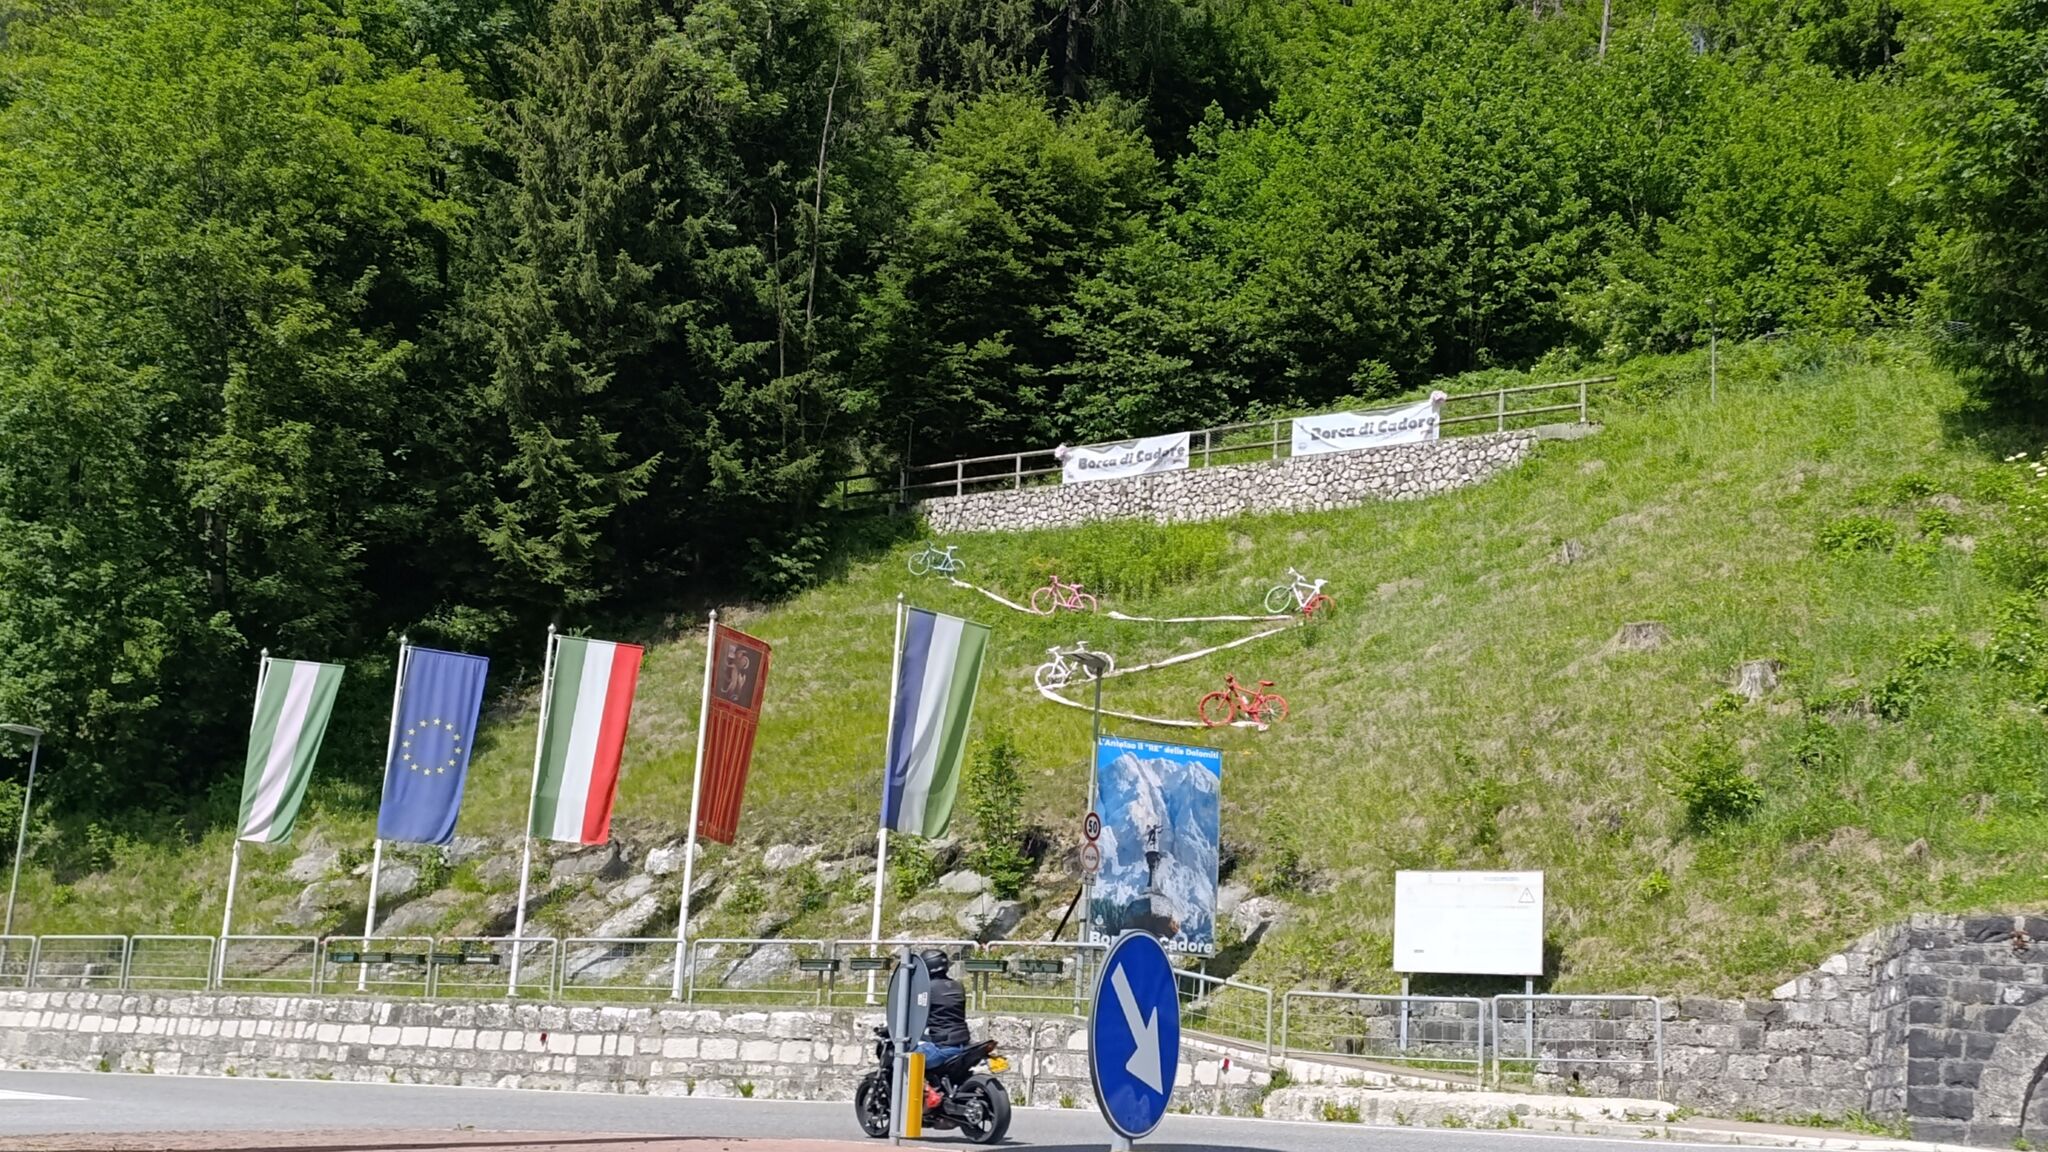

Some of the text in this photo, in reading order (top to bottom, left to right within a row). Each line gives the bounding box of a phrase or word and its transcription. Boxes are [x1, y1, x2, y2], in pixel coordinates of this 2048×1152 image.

[1310, 416, 1436, 441] Borca di Cadore
[1078, 458, 1117, 470] Borca
[1119, 453, 1133, 465] di
[1098, 738, 1137, 750] L'Antelao
[1138, 743, 1144, 751] il
[1186, 748, 1219, 760] Dolomiti
[1088, 820, 1098, 834] 50
[1089, 931, 1213, 954] Bor Cadore
